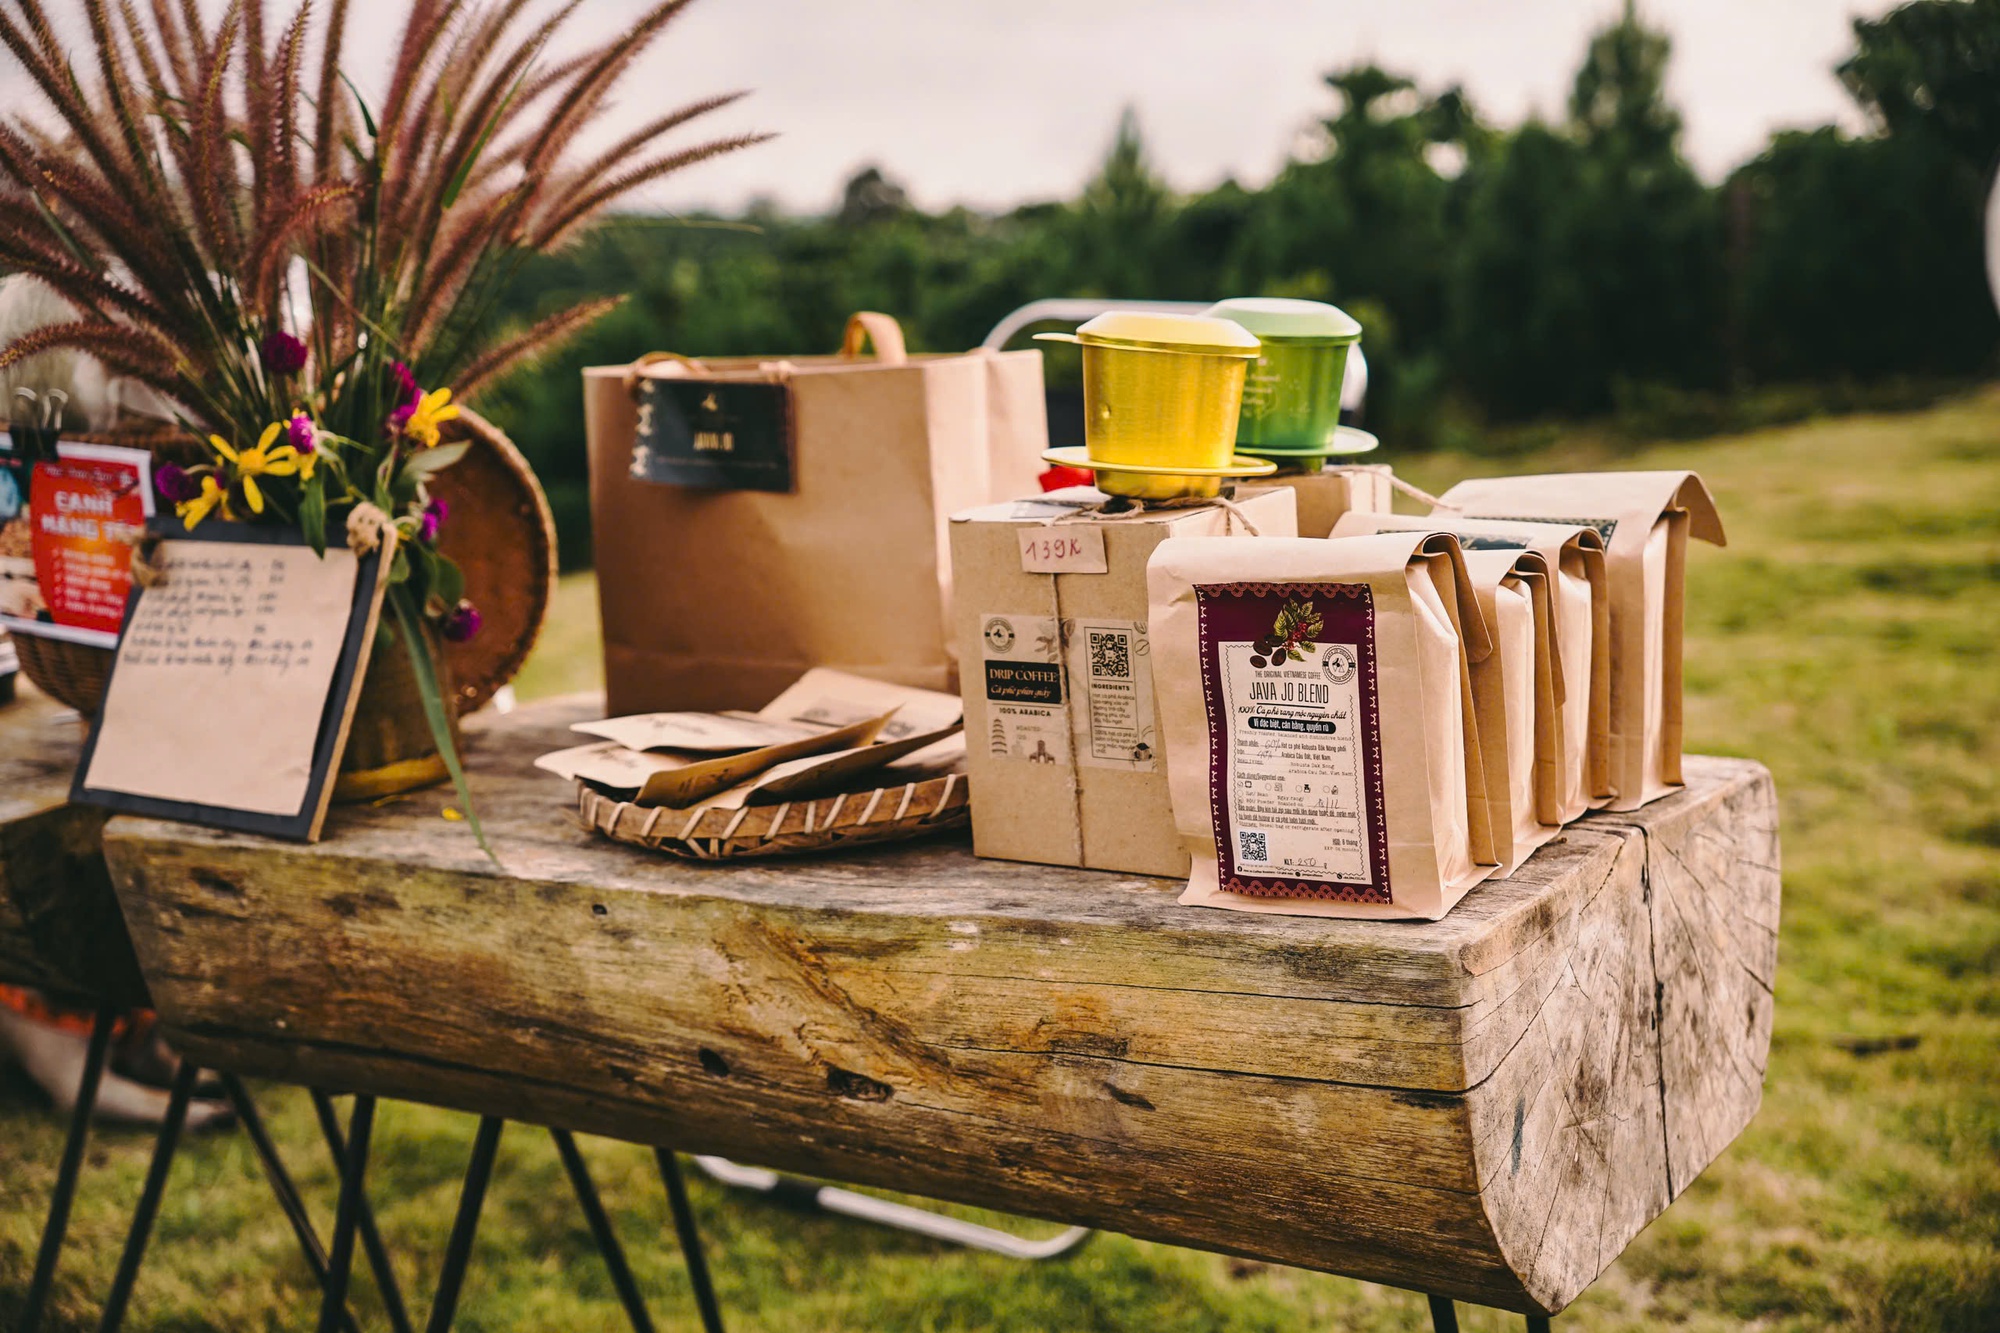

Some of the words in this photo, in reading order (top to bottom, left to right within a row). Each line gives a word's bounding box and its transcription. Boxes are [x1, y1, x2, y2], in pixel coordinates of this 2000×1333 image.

[1025, 538, 1081, 561] 139K
[989, 668, 1014, 680] DRIP
[1015, 669, 1057, 682] COFFEE
[1263, 671, 1282, 679] ORIGINAL
[1283, 671, 1307, 679] VIETNAMESE
[1308, 672, 1321, 680] COFFEE
[1091, 683, 1130, 692] INGREDIENTS
[1250, 682, 1277, 701] JAVA
[1281, 682, 1294, 702] JO
[1298, 683, 1329, 704] BLEND
[999, 707, 1017, 715] 100%
[1020, 708, 1052, 717] ARABICA
[1238, 706, 1255, 714] 100%
[1280, 709, 1293, 719] rang
[1297, 857, 1316, 867] 250
